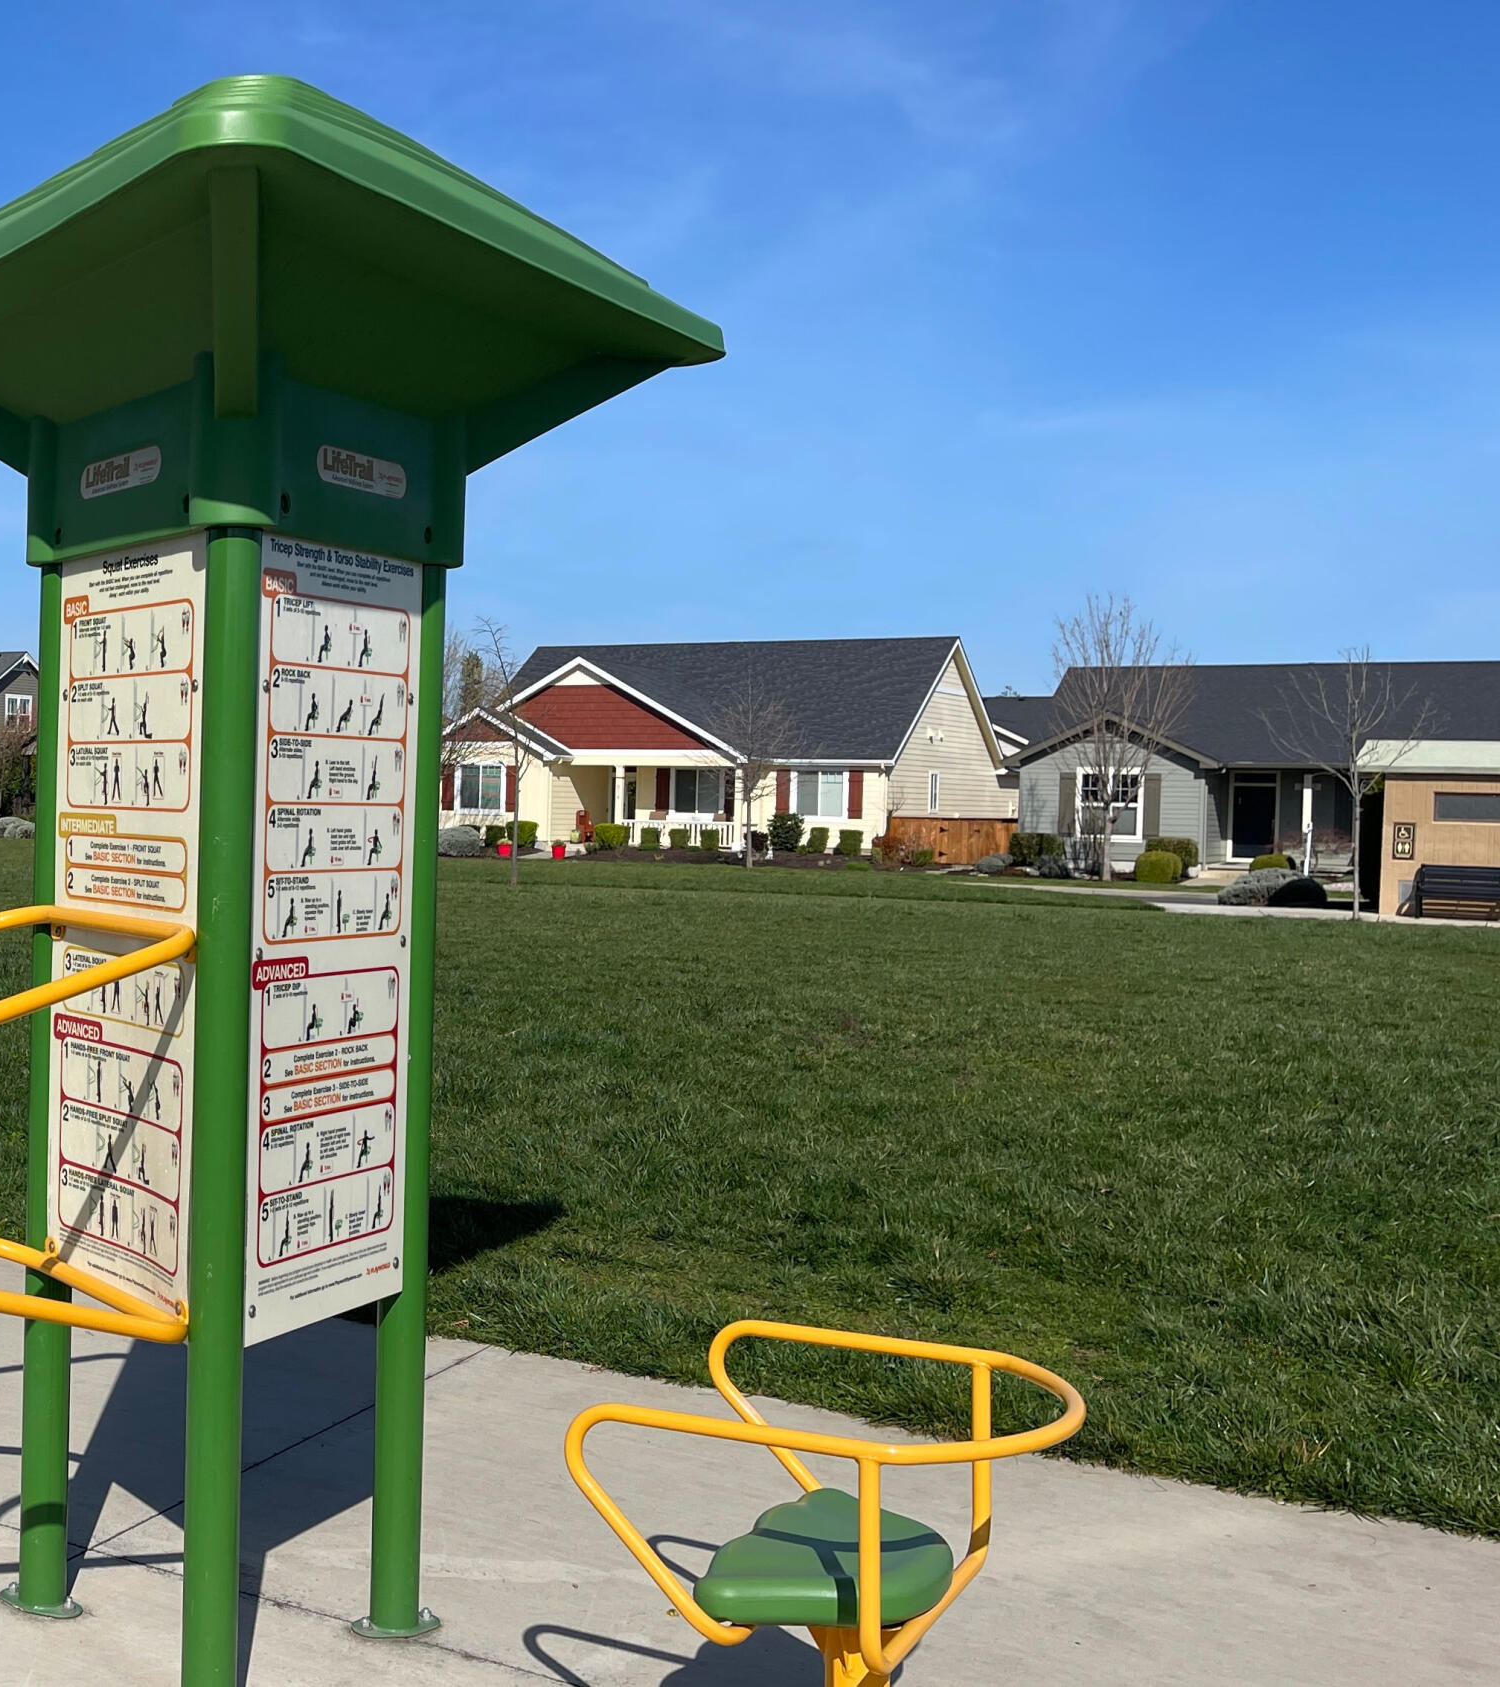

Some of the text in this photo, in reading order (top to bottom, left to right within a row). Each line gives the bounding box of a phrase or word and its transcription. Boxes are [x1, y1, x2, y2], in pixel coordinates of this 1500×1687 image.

[85, 456, 130, 488] LifeTrail
[324, 448, 374, 481] LifeTrail
[103, 553, 158, 576] Squat Exercises
[270, 538, 292, 557] Tricep
[295, 542, 325, 563] Strength
[327, 550, 332, 562] &
[334, 551, 354, 566] Torso
[355, 554, 381, 574] Stability
[383, 560, 414, 577] Exercises
[265, 576, 294, 594] BASIC
[66, 601, 88, 617] BASIC
[276, 598, 280, 617] 1
[284, 598, 313, 608] TRICEP LIFT
[74, 622, 77, 639] 1
[273, 668, 280, 688] 2
[281, 668, 311, 679] ROCK BACK
[71, 686, 77, 702] 2
[271, 738, 278, 758] 3
[279, 738, 312, 747] SIDE-TO-SIDE
[70, 748, 76, 766] 3
[269, 809, 276, 828] 4
[277, 808, 321, 816] SPINAL ROTATION
[60, 818, 114, 834] INTERMEDIATE
[68, 840, 73, 857] 1
[90, 841, 108, 850] Complete
[109, 842, 126, 851] Exercise
[133, 844, 147, 853] FRONT
[93, 851, 110, 862] BASIC
[111, 853, 135, 864] SECTION
[68, 872, 74, 889] 2
[91, 874, 110, 883] Complete
[111, 875, 127, 885] Exercise
[134, 879, 145, 887] SPLIT
[146, 880, 160, 888] SQUAT
[268, 880, 275, 898] 5
[93, 884, 110, 895] BASIC
[111, 886, 135, 898] SECTION
[66, 953, 71, 970] 3
[256, 963, 306, 982] ADVANCED
[266, 987, 270, 1006] 1
[273, 984, 291, 992] TRICEP
[56, 1019, 100, 1040] ADVANCED
[64, 1041, 68, 1058] 1
[294, 1053, 314, 1063] Complete
[316, 1049, 334, 1059] Exercise
[341, 1046, 354, 1054] ROCK
[356, 1044, 368, 1053] BACK
[264, 1058, 271, 1078] 2
[285, 1069, 293, 1077] See
[294, 1062, 314, 1075] BASIC
[314, 1058, 342, 1072] SECTION
[291, 1089, 312, 1099] Complete
[313, 1085, 331, 1095] Exercise
[339, 1078, 368, 1090] SIDE-TO-SIDE
[263, 1096, 270, 1116] 3
[284, 1105, 292, 1113] See
[293, 1098, 312, 1111] BASIC
[314, 1093, 341, 1107] SECTION
[63, 1104, 69, 1121] 2
[271, 1121, 314, 1137] SPINAL ROTATION
[263, 1132, 270, 1151] 4
[62, 1168, 68, 1186] 3
[262, 1202, 269, 1222] 5
